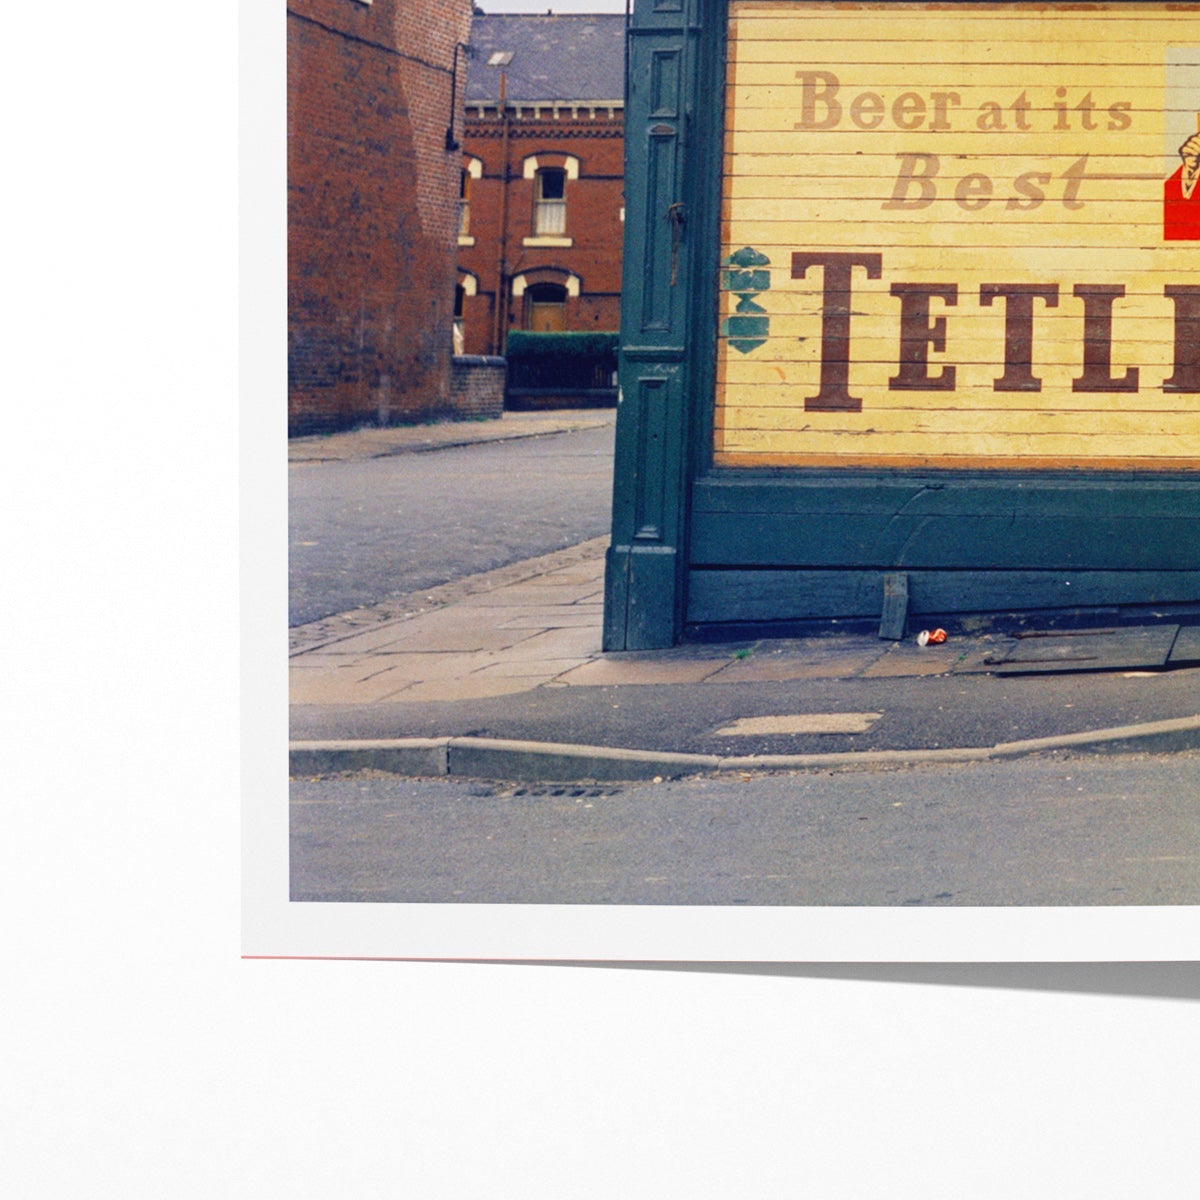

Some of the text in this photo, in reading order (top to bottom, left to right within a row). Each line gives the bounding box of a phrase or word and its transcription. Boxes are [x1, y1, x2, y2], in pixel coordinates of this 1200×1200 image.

[793, 70, 1133, 132] Beer at its
[881, 152, 1092, 212] Best
